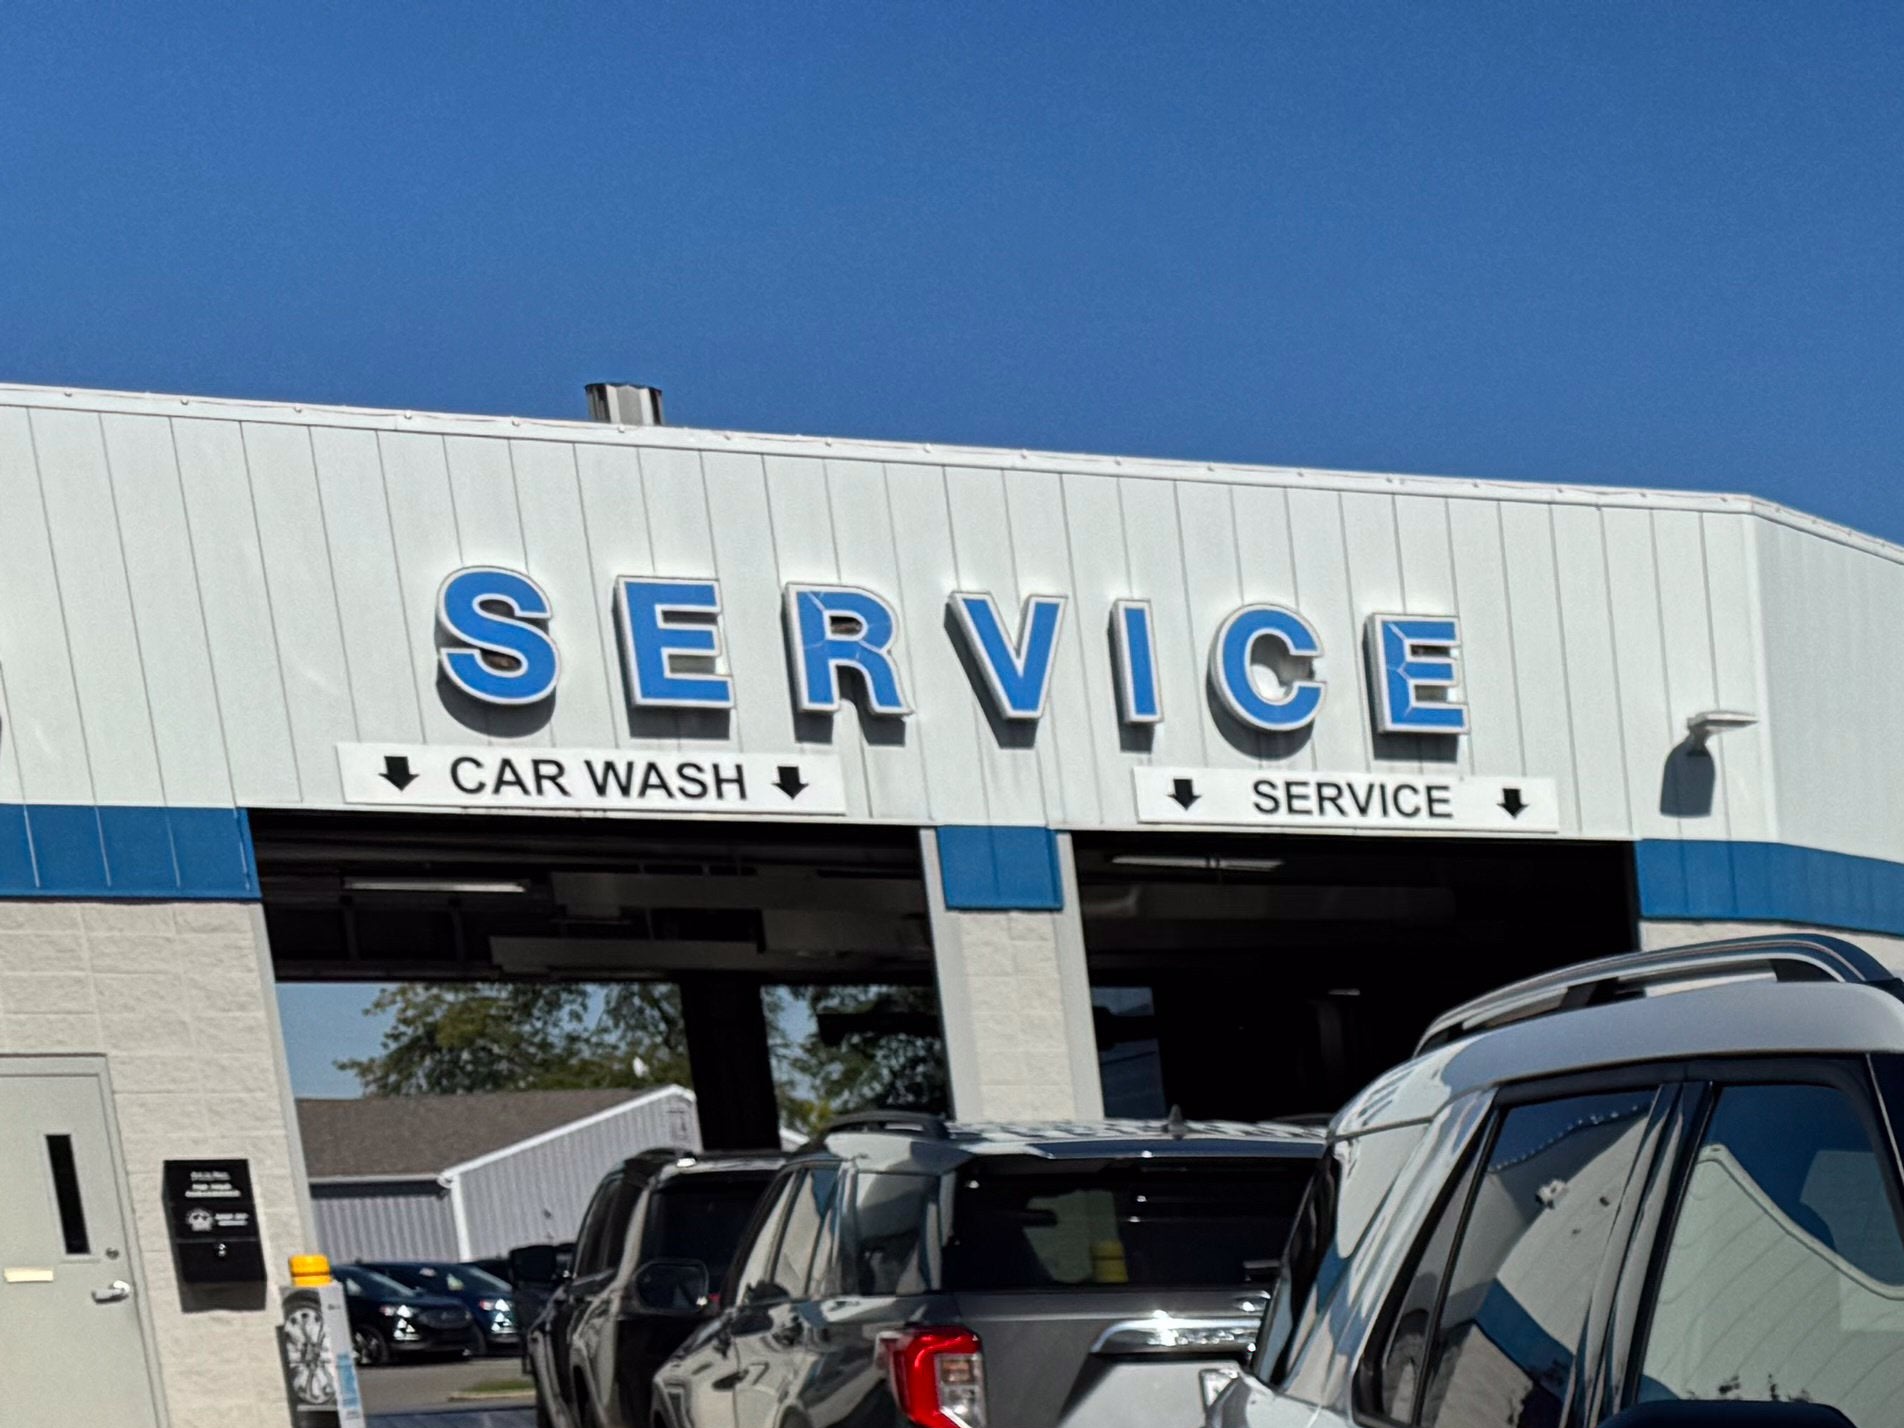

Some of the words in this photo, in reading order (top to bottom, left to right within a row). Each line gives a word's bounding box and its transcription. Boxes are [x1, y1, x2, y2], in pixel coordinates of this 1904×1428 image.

[437, 564, 1470, 735] SERVICE
[450, 756, 571, 798] CAR
[585, 758, 748, 801] WASH
[1252, 779, 1455, 821] SERVICE
